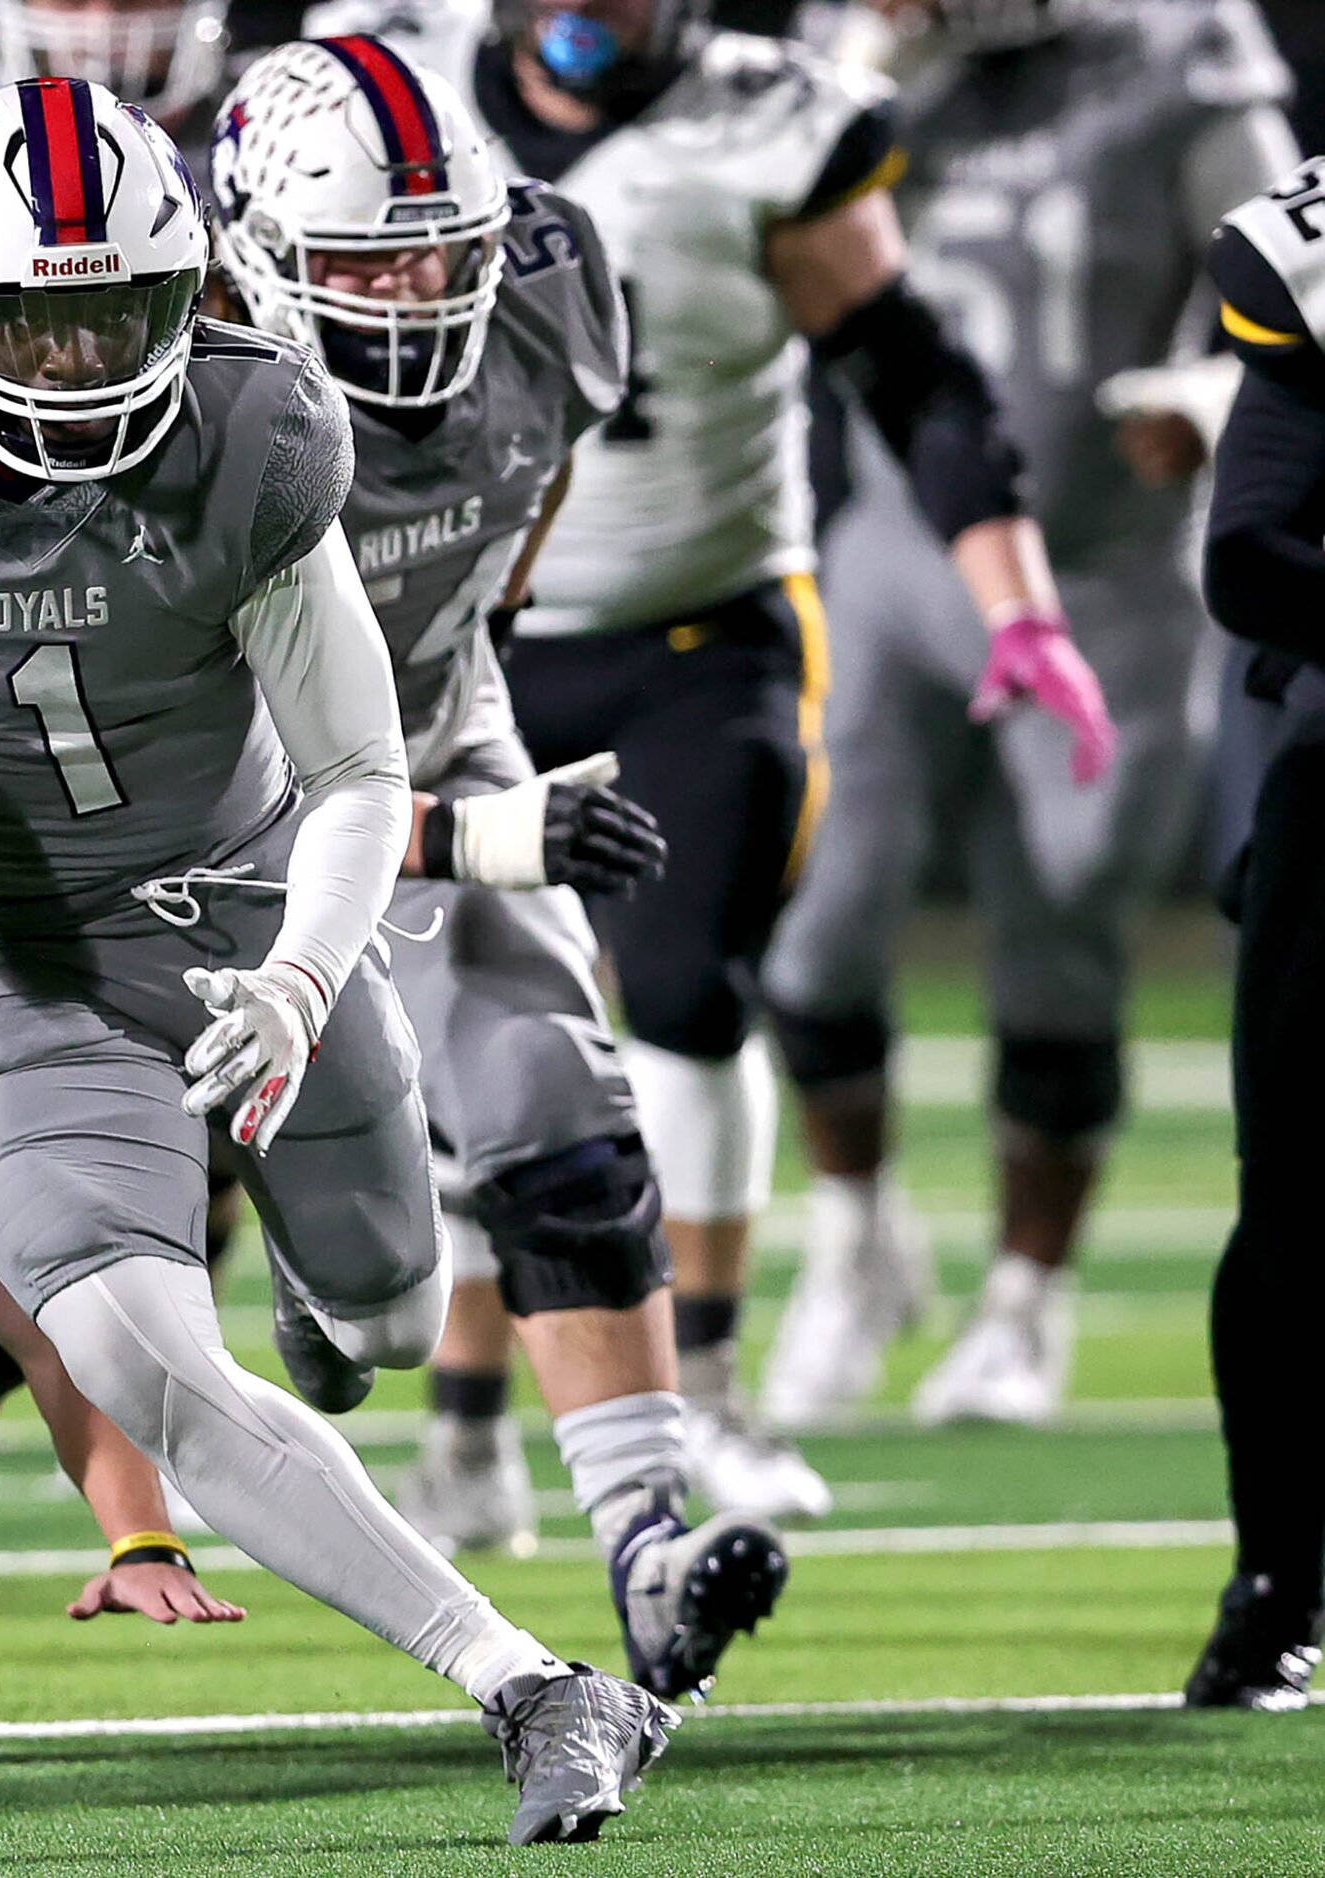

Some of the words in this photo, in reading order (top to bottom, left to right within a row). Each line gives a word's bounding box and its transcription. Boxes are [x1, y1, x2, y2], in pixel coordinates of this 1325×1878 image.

[32, 253, 120, 277] Riddell
[47, 456, 87, 469] Riddell
[357, 495, 484, 571] ROYALS
[7, 641, 131, 818] 1
